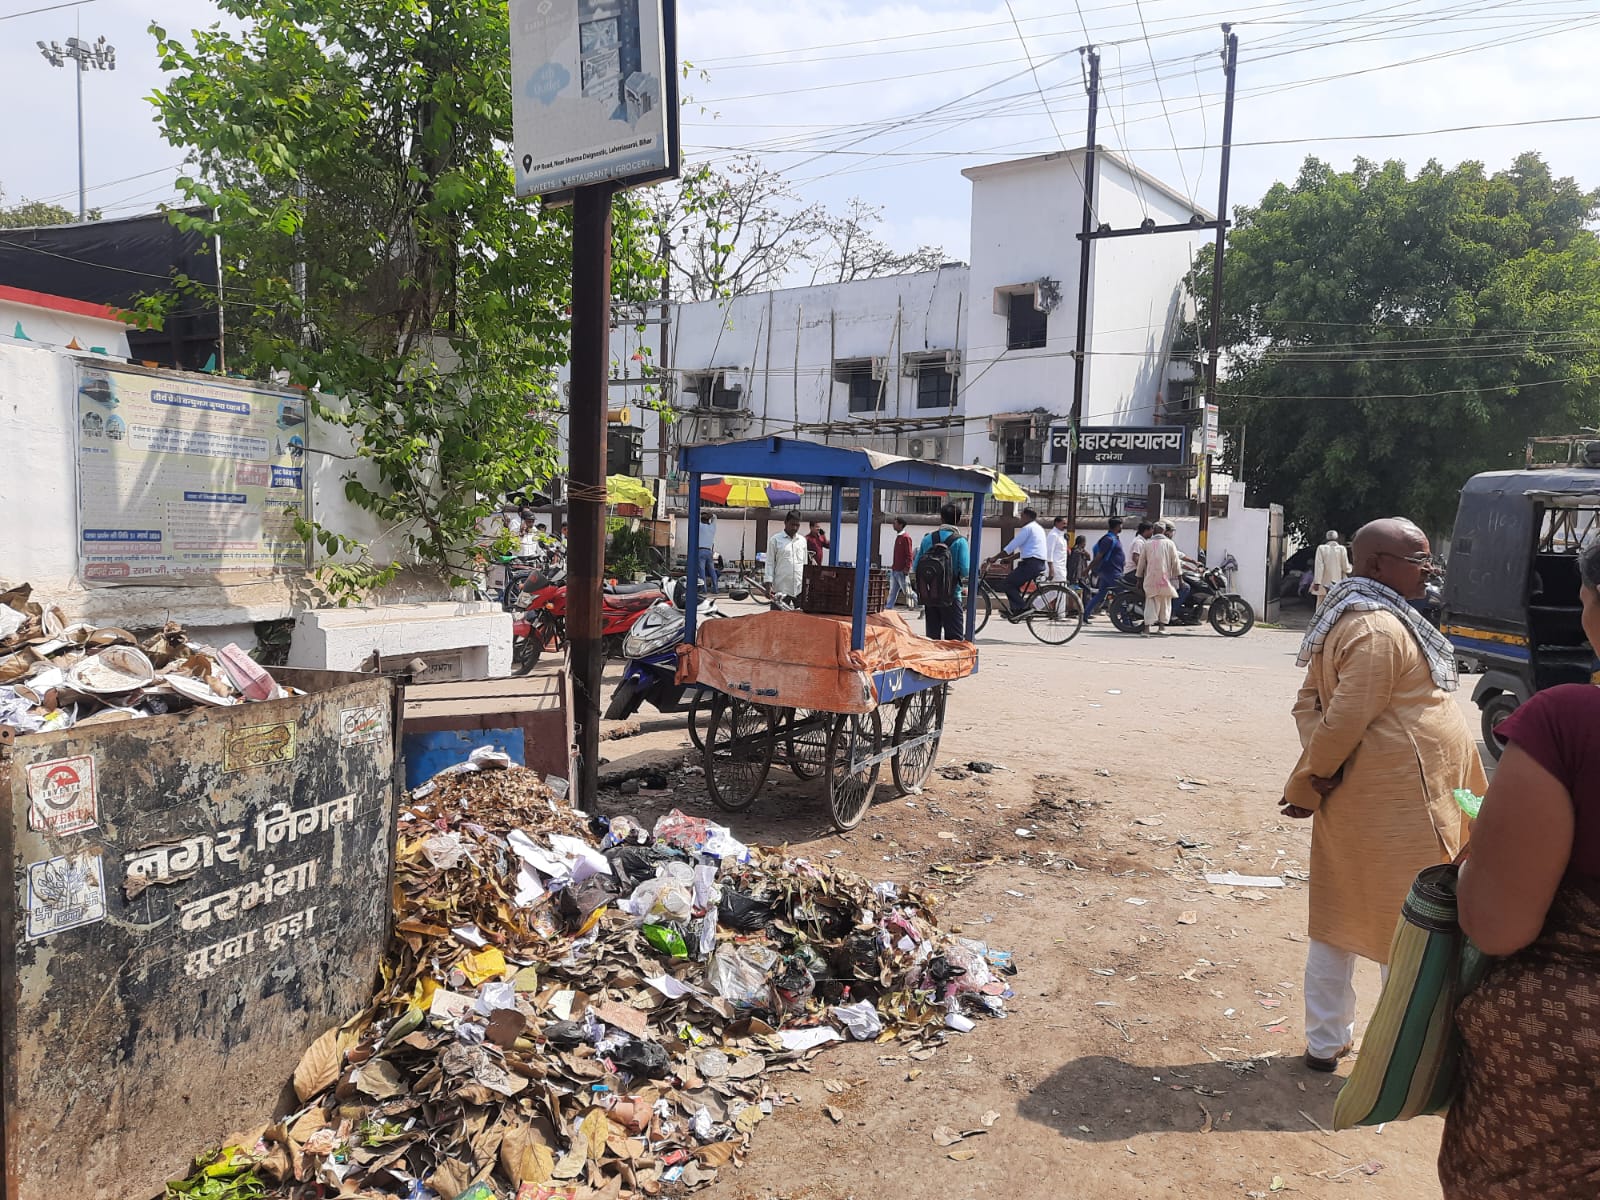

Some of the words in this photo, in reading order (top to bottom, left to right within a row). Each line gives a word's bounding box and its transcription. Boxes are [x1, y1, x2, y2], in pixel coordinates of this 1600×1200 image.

[529, 180, 556, 193] SWEETS
[562, 168, 608, 186] RESTAURANT
[615, 160, 651, 173] GROCERY
[1095, 451, 1123, 461] दरभंगा
[1110, 432, 1182, 450] न्यायालय
[123, 826, 245, 882] नगर
[254, 792, 356, 854] निगम
[180, 857, 322, 932] दरभंगा
